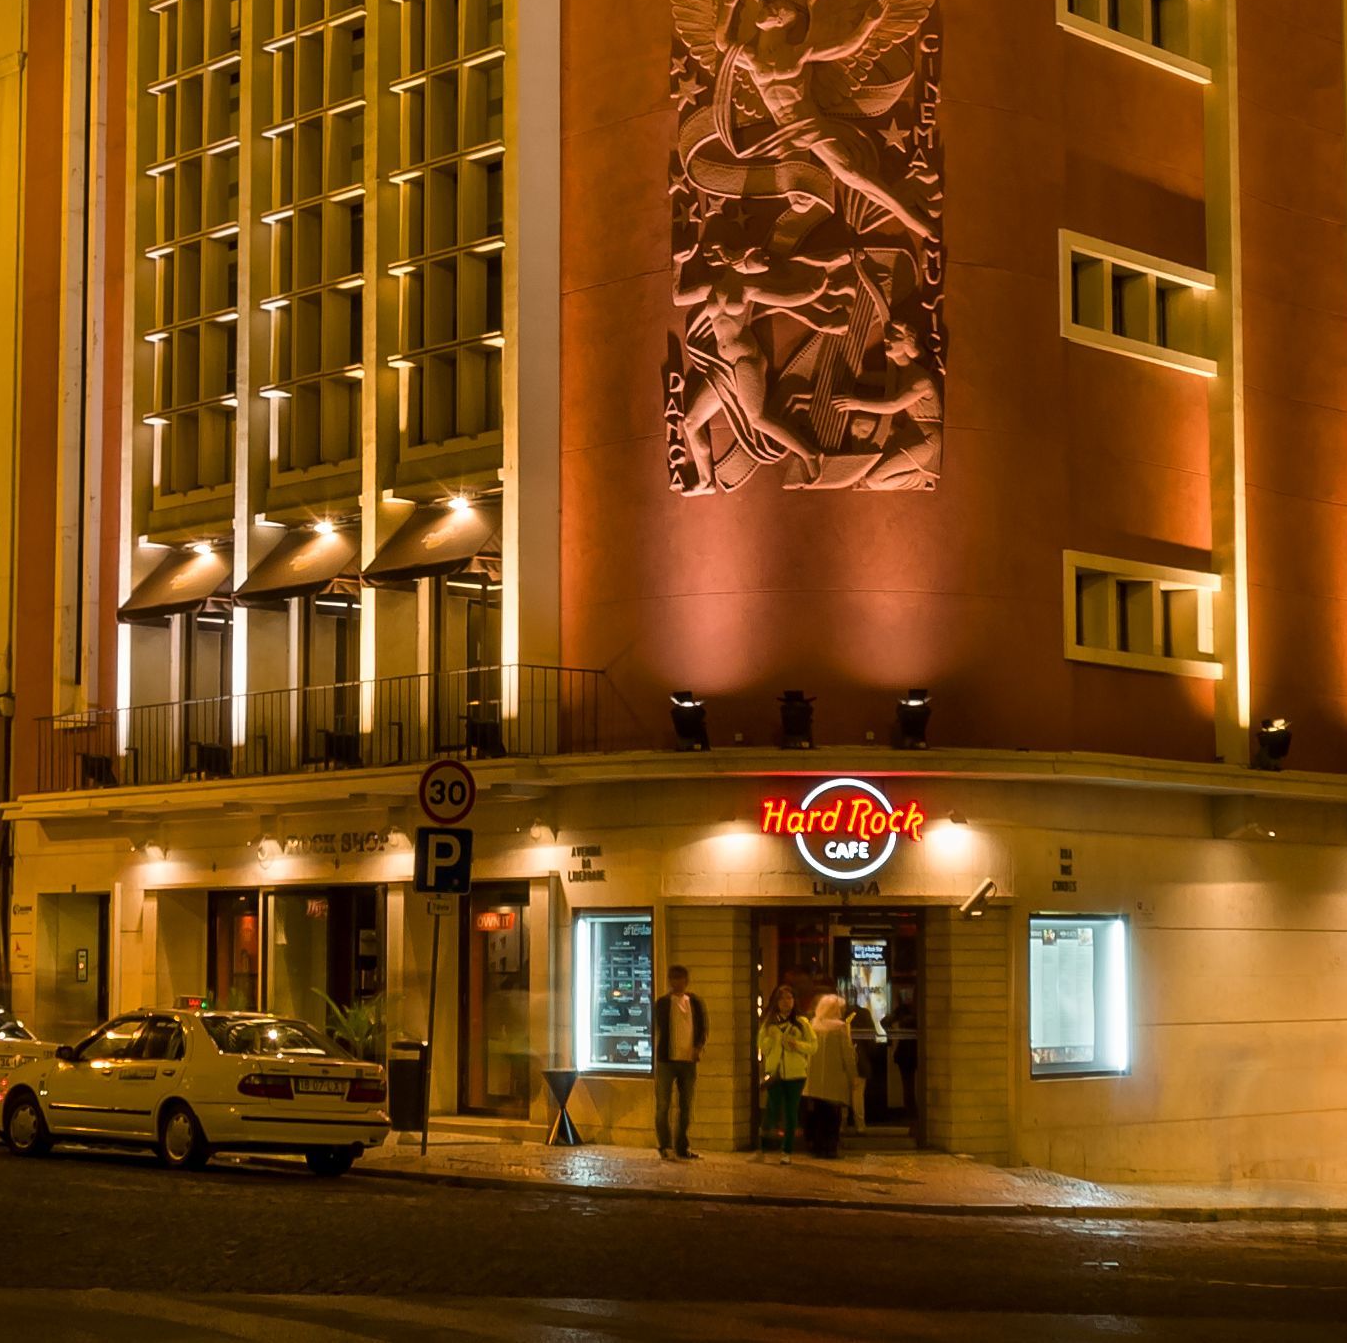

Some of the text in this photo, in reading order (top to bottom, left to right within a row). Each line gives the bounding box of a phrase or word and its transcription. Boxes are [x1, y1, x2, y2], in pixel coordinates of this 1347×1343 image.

[909, 34, 941, 169] CINEMA
[664, 372, 686, 491] DANÇA
[429, 779, 467, 806] 30
[762, 798, 924, 842] Hard Rock
[426, 833, 461, 887] P
[824, 841, 870, 859] CAFE
[477, 914, 511, 927] OWN IT
